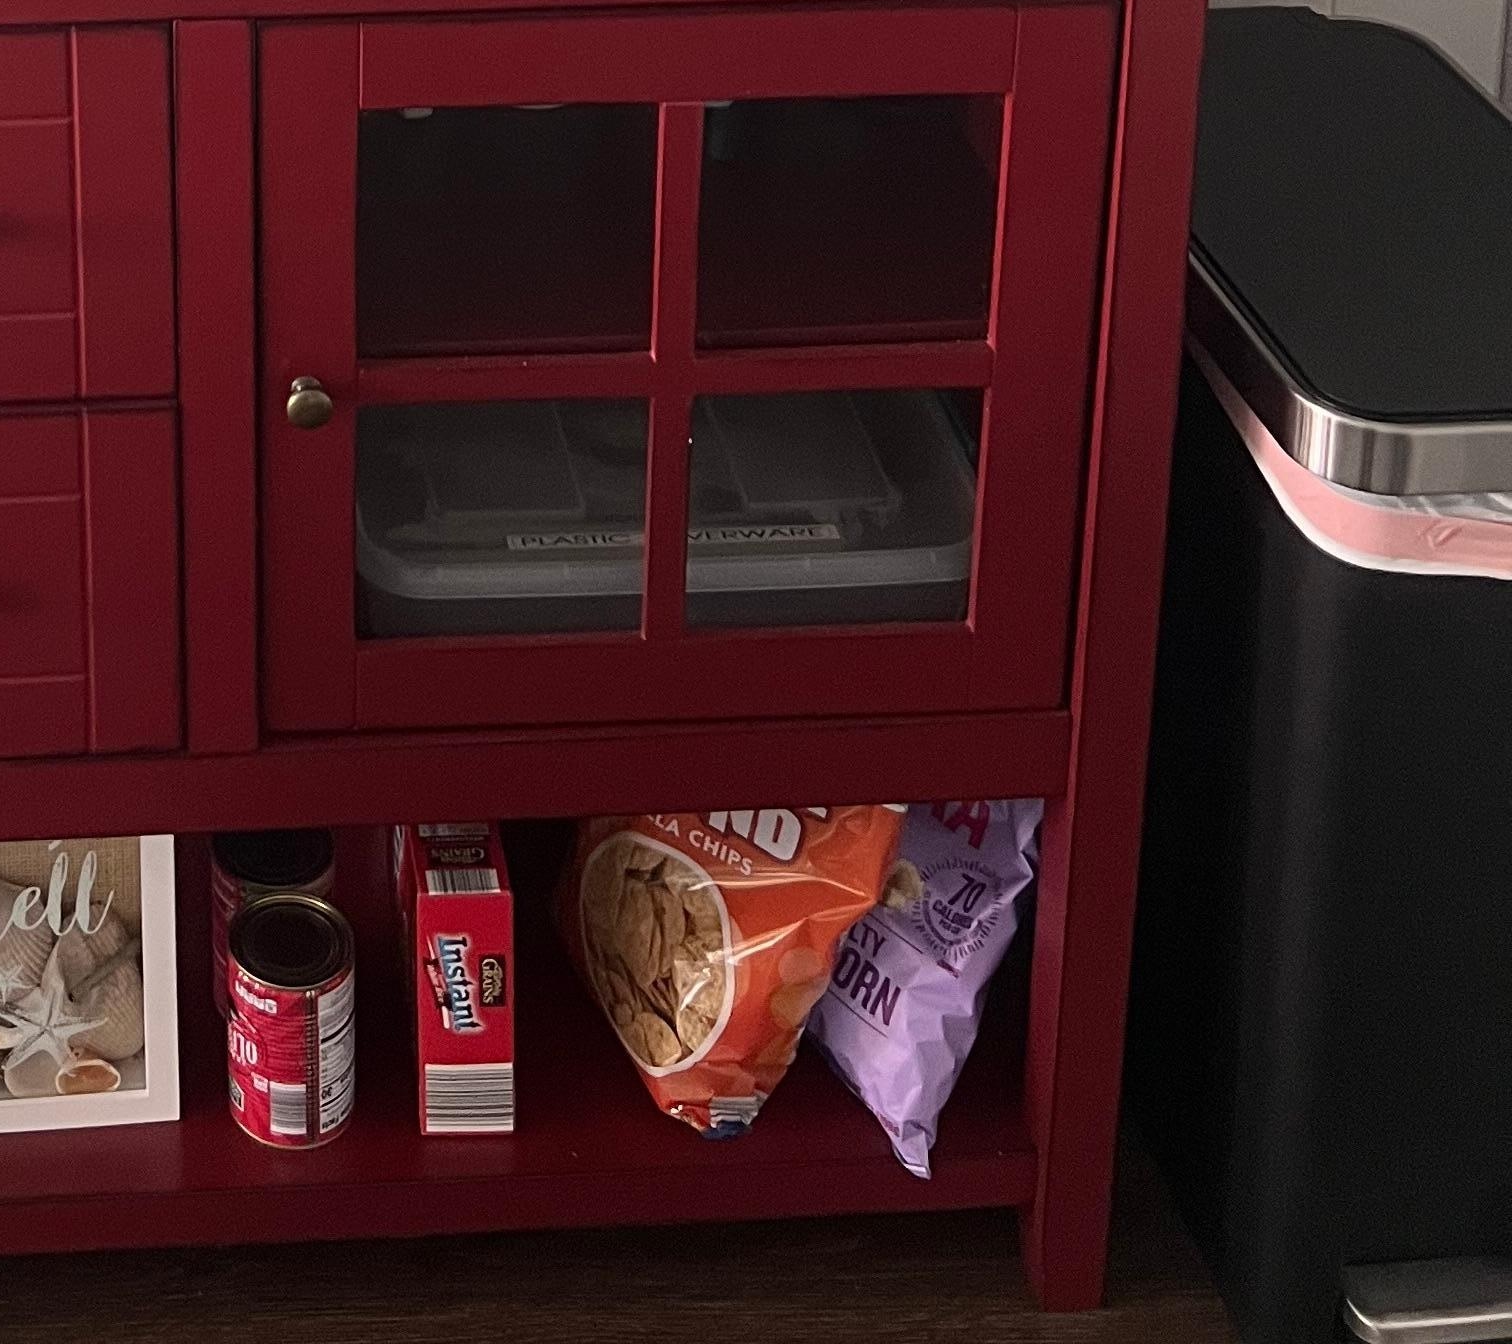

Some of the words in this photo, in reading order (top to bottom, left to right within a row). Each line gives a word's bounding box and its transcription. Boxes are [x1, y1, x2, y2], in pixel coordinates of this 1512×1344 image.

[688, 829, 753, 877] CHIPS
[947, 872, 988, 913] 70
[437, 936, 482, 1028] Instant
